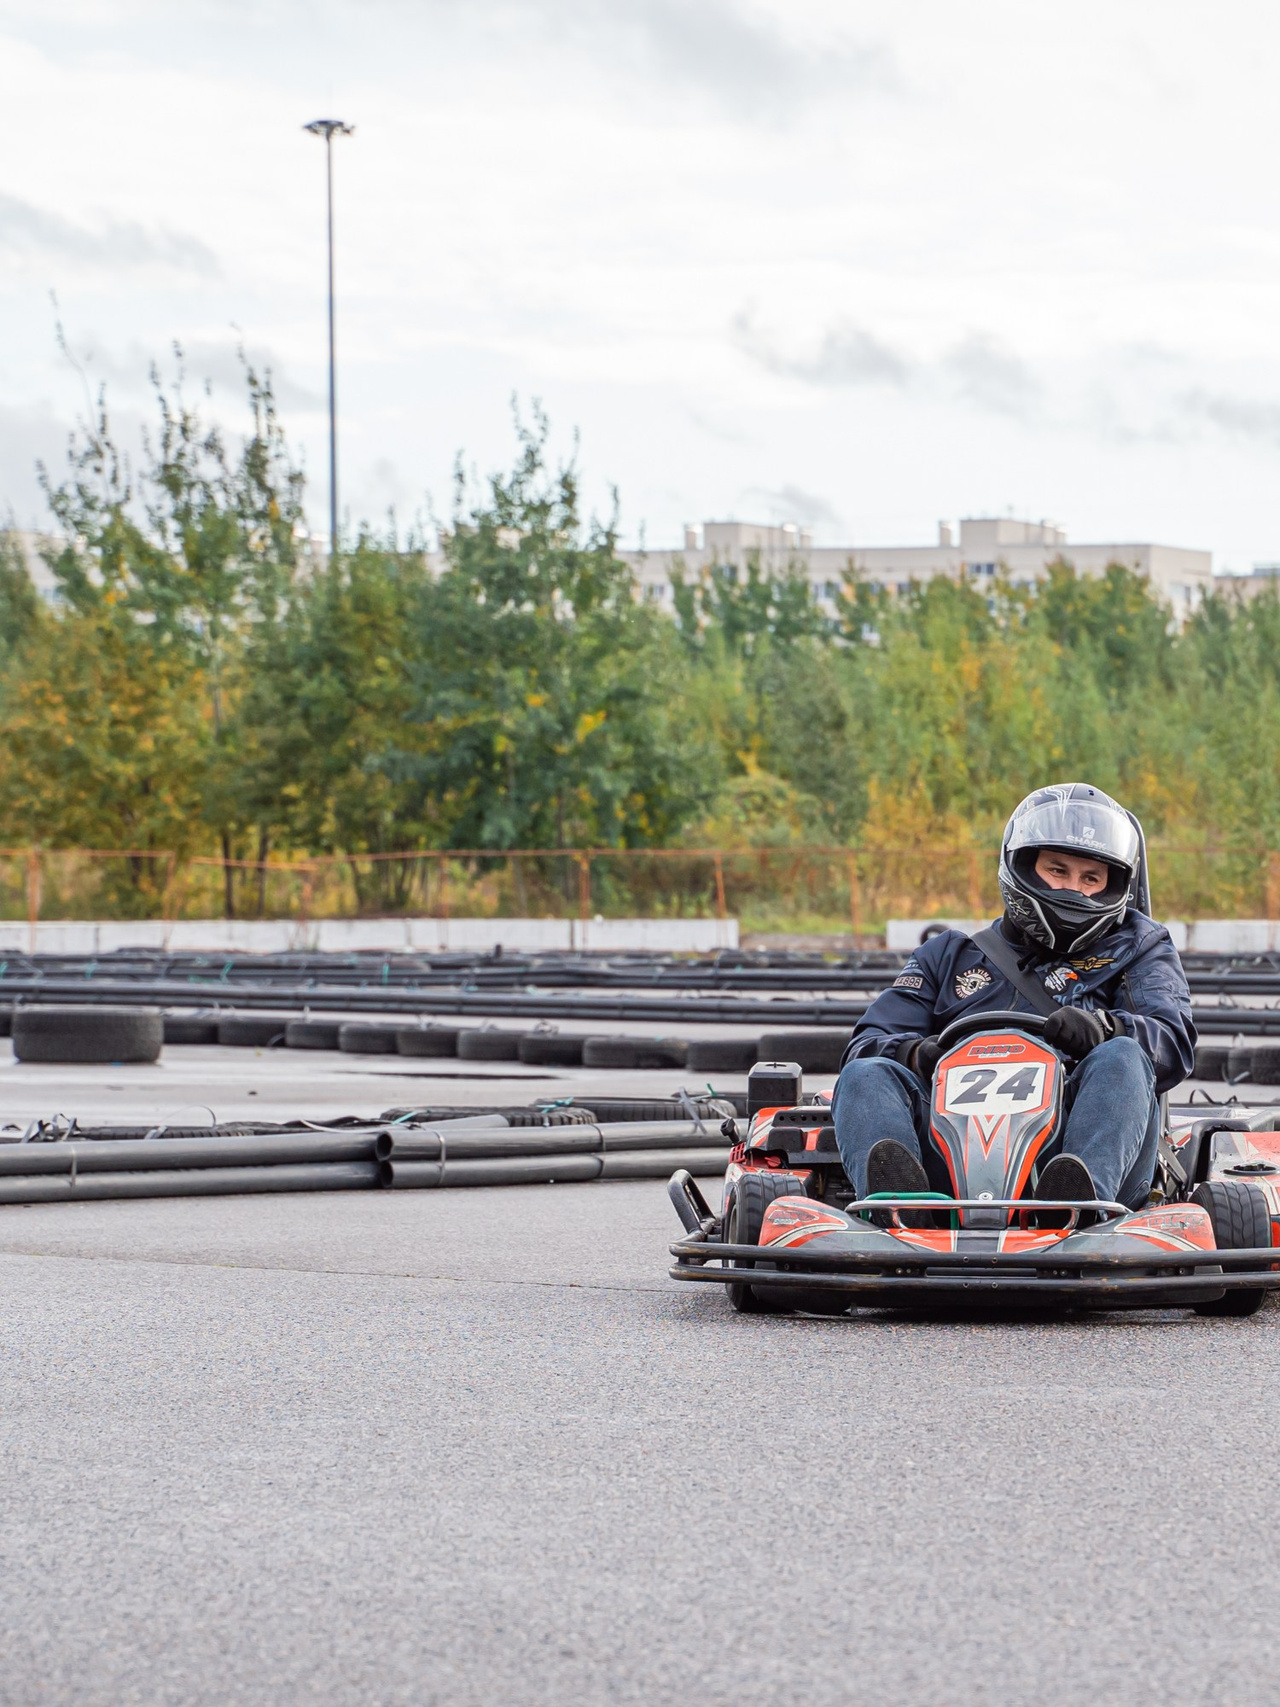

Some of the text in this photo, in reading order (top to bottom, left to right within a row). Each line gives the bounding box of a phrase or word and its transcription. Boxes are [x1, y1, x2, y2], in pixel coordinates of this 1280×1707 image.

[1066, 834, 1107, 851] SHARK
[969, 1045, 1025, 1056] DINO
[949, 1067, 1040, 1105] 24
